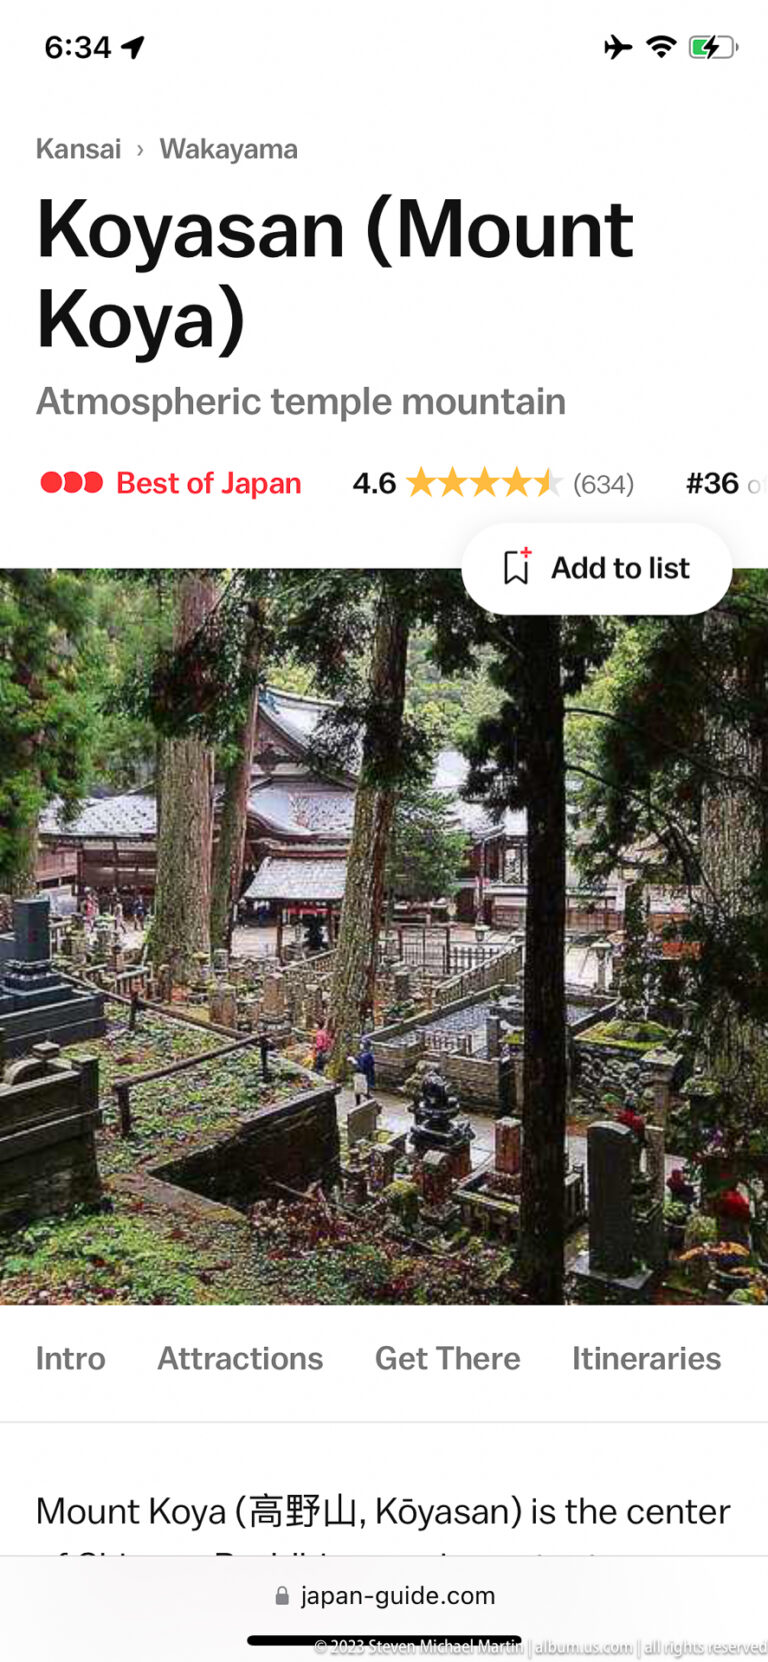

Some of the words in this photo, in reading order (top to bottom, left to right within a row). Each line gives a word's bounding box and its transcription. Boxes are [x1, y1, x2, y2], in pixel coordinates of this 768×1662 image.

[45, 35, 112, 59] 6:34
[36, 138, 121, 159] Kansai
[159, 138, 298, 164] Wakayama
[39, 198, 343, 273] Koyasan
[367, 194, 634, 268] (Mount
[39, 284, 244, 363] Koya)
[36, 386, 262, 422] Atmospheric
[271, 387, 393, 422] temple
[402, 387, 566, 415] mountain
[116, 471, 181, 494] Best
[186, 471, 214, 494] of
[220, 471, 302, 500] Japan
[352, 472, 397, 494] 4.6
[573, 472, 634, 498] (634)
[686, 472, 739, 494] #36
[551, 556, 606, 579] Add
[612, 558, 642, 579] to
[649, 556, 690, 579] list
[36, 1346, 106, 1370] Intro
[157, 1346, 324, 1370] Attractions
[375, 1346, 429, 1370] Get
[436, 1346, 521, 1370] There
[573, 1346, 722, 1370] Itineraries
[37, 1497, 140, 1525] Mount
[149, 1497, 226, 1532] Koya
[376, 1495, 522, 1532] Kōyasan)
[532, 1498, 557, 1525] is
[565, 1497, 618, 1525] the
[626, 1499, 732, 1525] center
[300, 1585, 496, 1610] japan-guide.com
